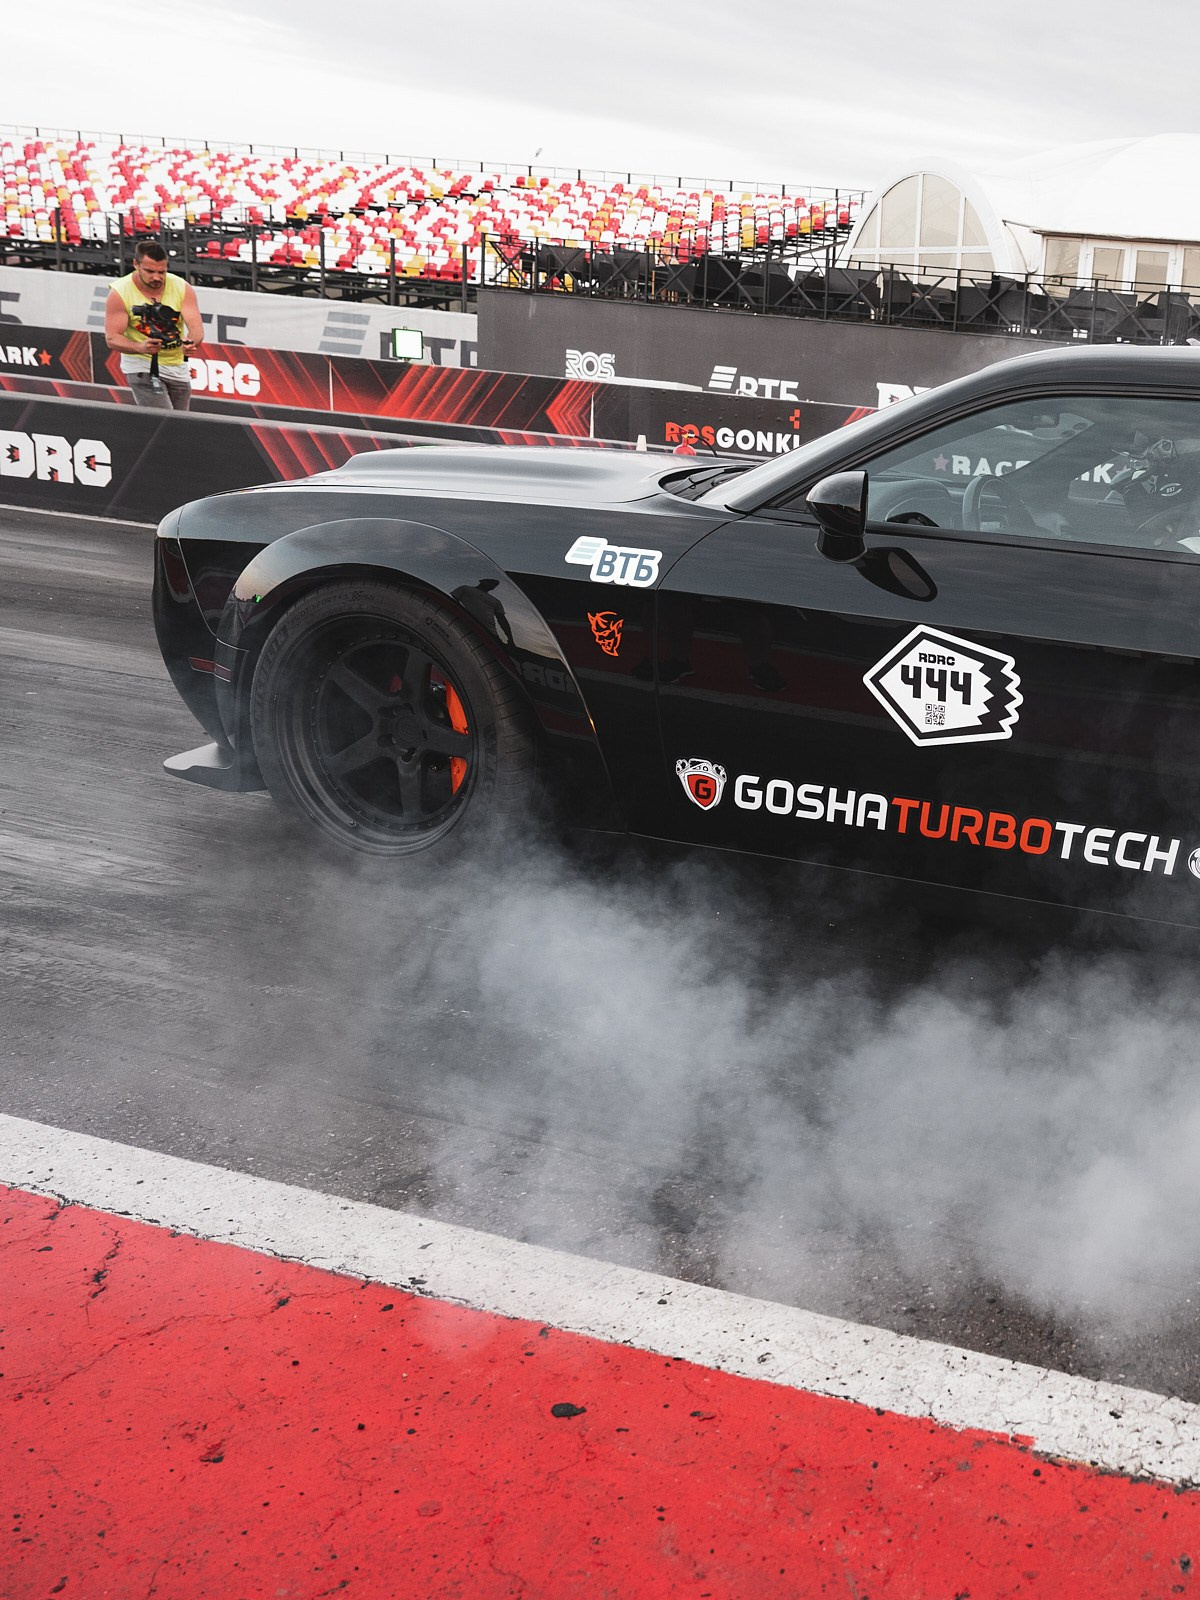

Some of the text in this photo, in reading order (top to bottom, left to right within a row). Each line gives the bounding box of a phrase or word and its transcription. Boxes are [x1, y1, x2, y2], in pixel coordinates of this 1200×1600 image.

[565, 349, 615, 379] ROS
[596, 550, 656, 582] ВТБ
[918, 652, 956, 667] RDRC
[901, 664, 972, 706] 444
[695, 779, 711, 800] G
[735, 775, 1180, 875] GOSHATURBOTECH
